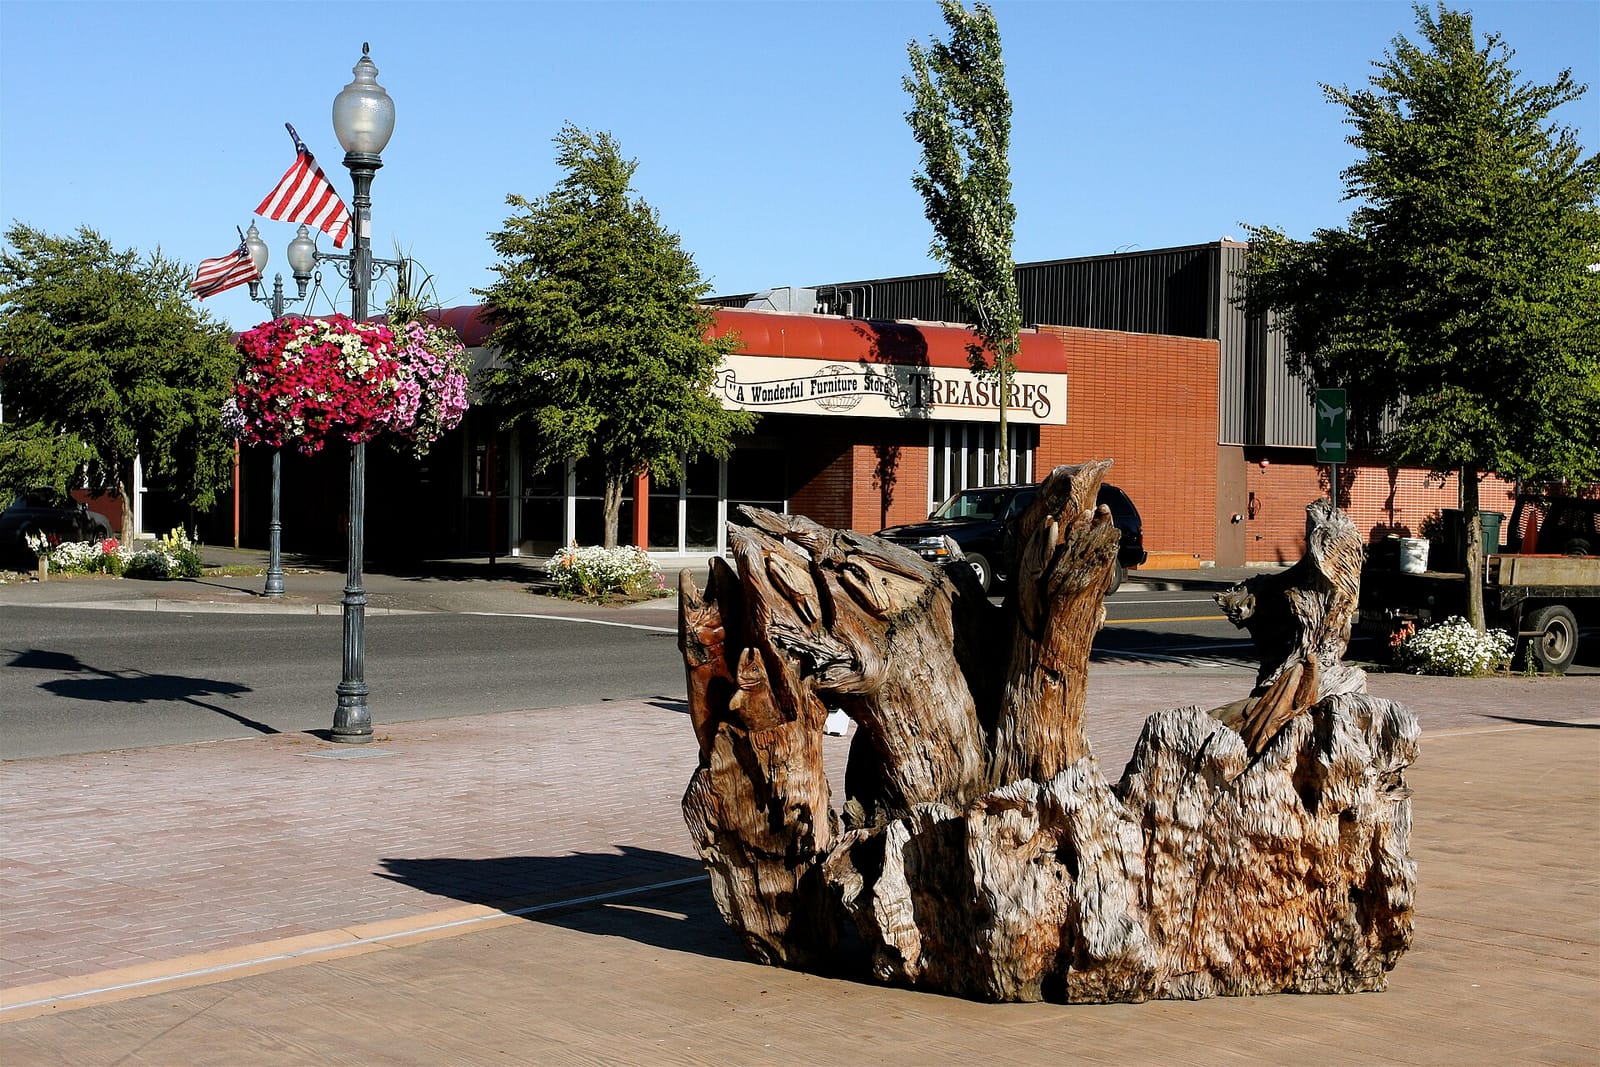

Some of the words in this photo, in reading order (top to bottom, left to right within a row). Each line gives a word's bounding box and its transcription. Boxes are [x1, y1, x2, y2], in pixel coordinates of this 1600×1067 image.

[751, 382, 804, 403] Wonderful
[810, 377, 858, 396] Furniture
[908, 373, 1051, 418] TREASURES
